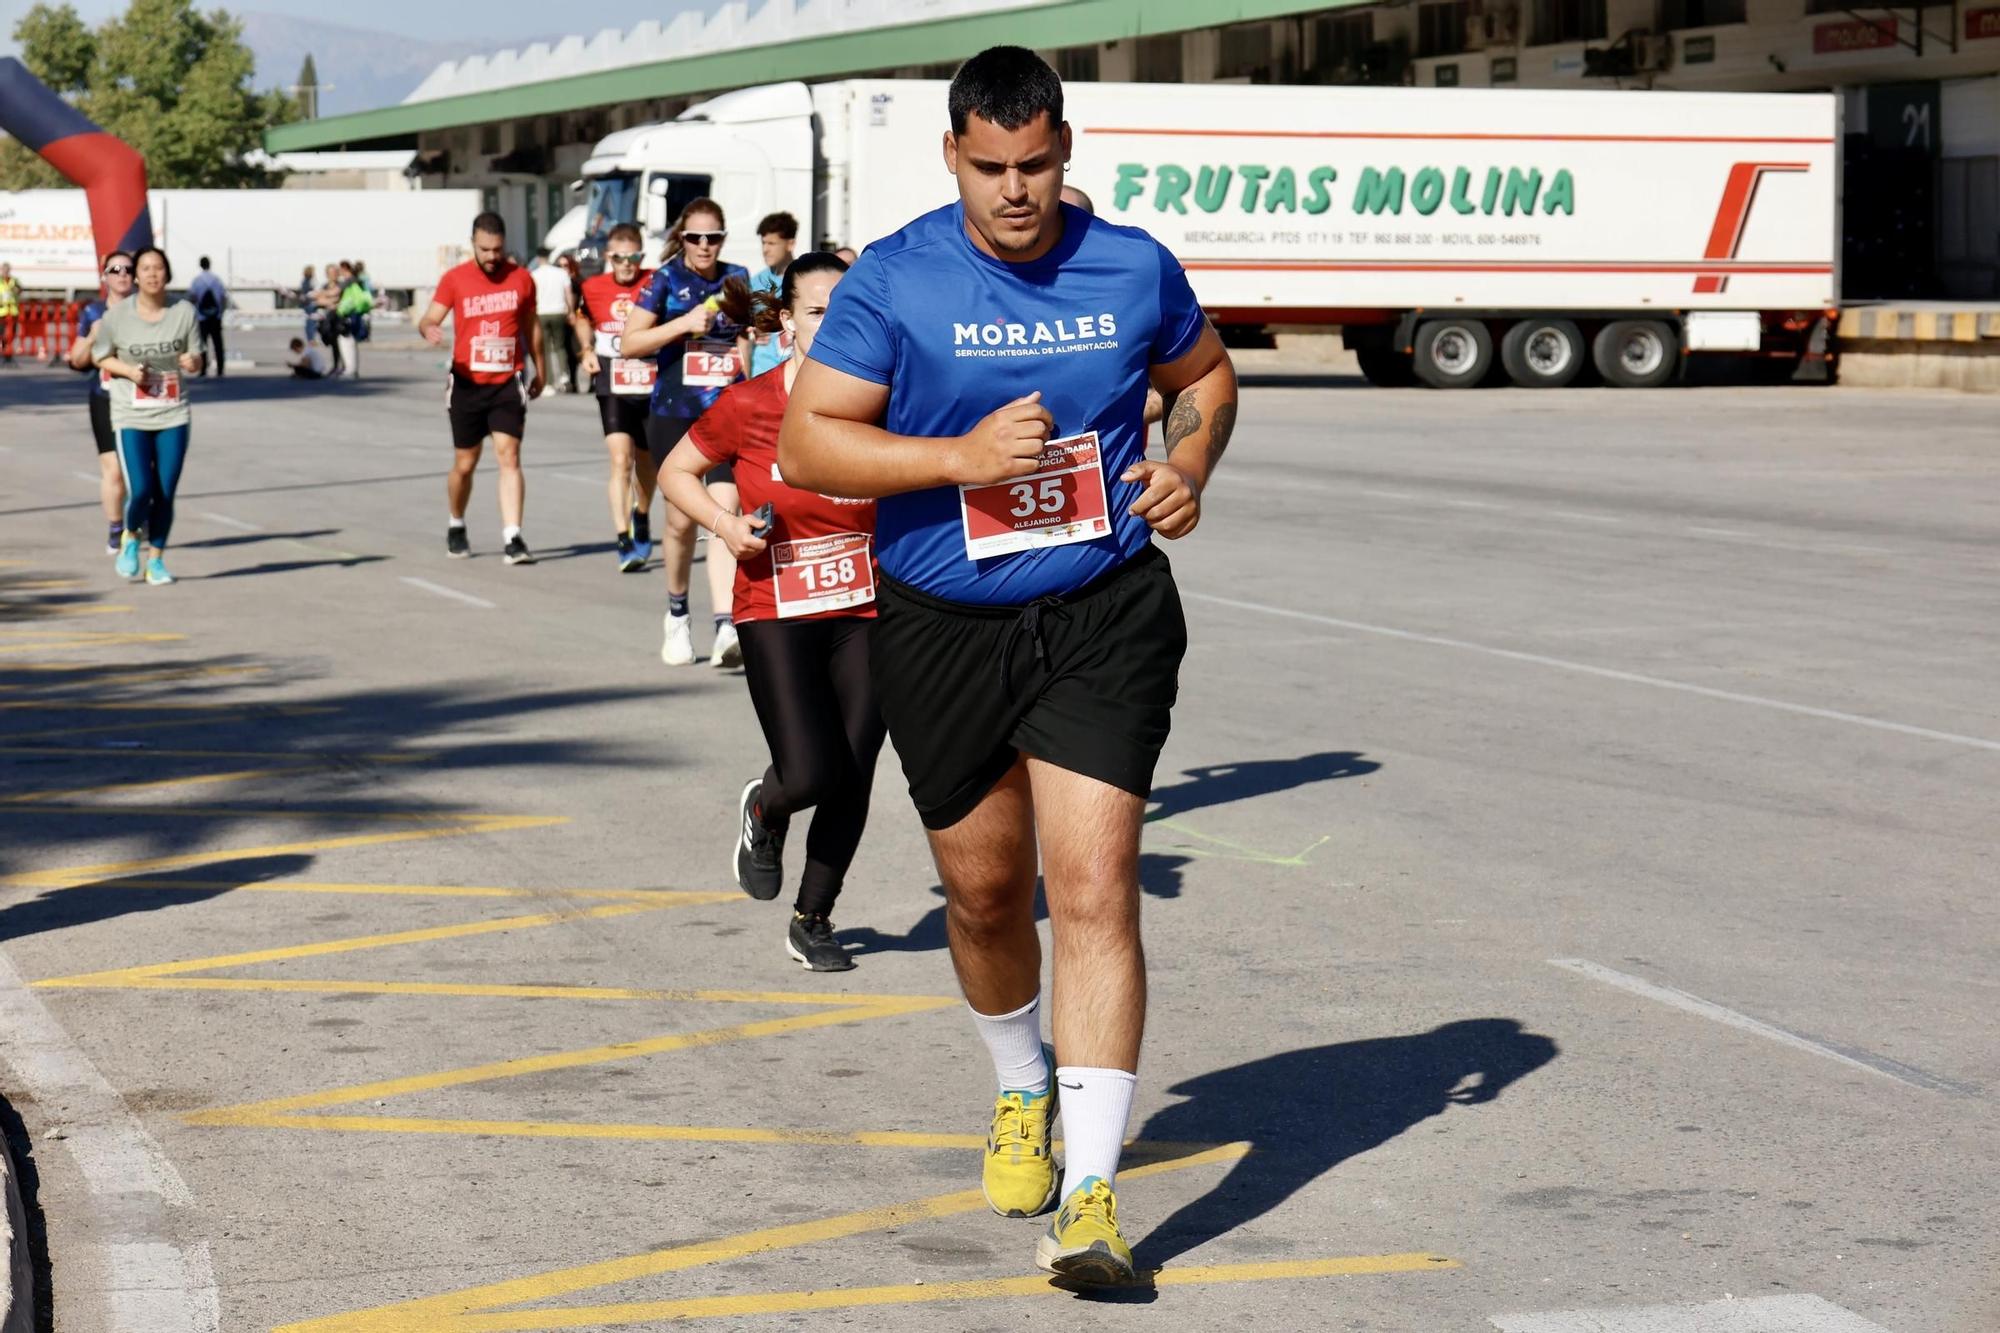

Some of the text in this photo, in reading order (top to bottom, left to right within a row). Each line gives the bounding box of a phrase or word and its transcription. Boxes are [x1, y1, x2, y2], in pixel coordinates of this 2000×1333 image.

[1113, 164, 1575, 216] FRUTAS MOLINA
[953, 313, 1118, 346] MORALES
[955, 340, 1118, 358] SERVICIO INTEGRAL DE ALIMENTACIÓN
[698, 355, 735, 372] 128
[1047, 442, 1094, 459] SOLIDARIA
[1009, 478, 1065, 517] 35
[1013, 516, 1062, 530] ALEJANDRO
[799, 558, 856, 591] 158
